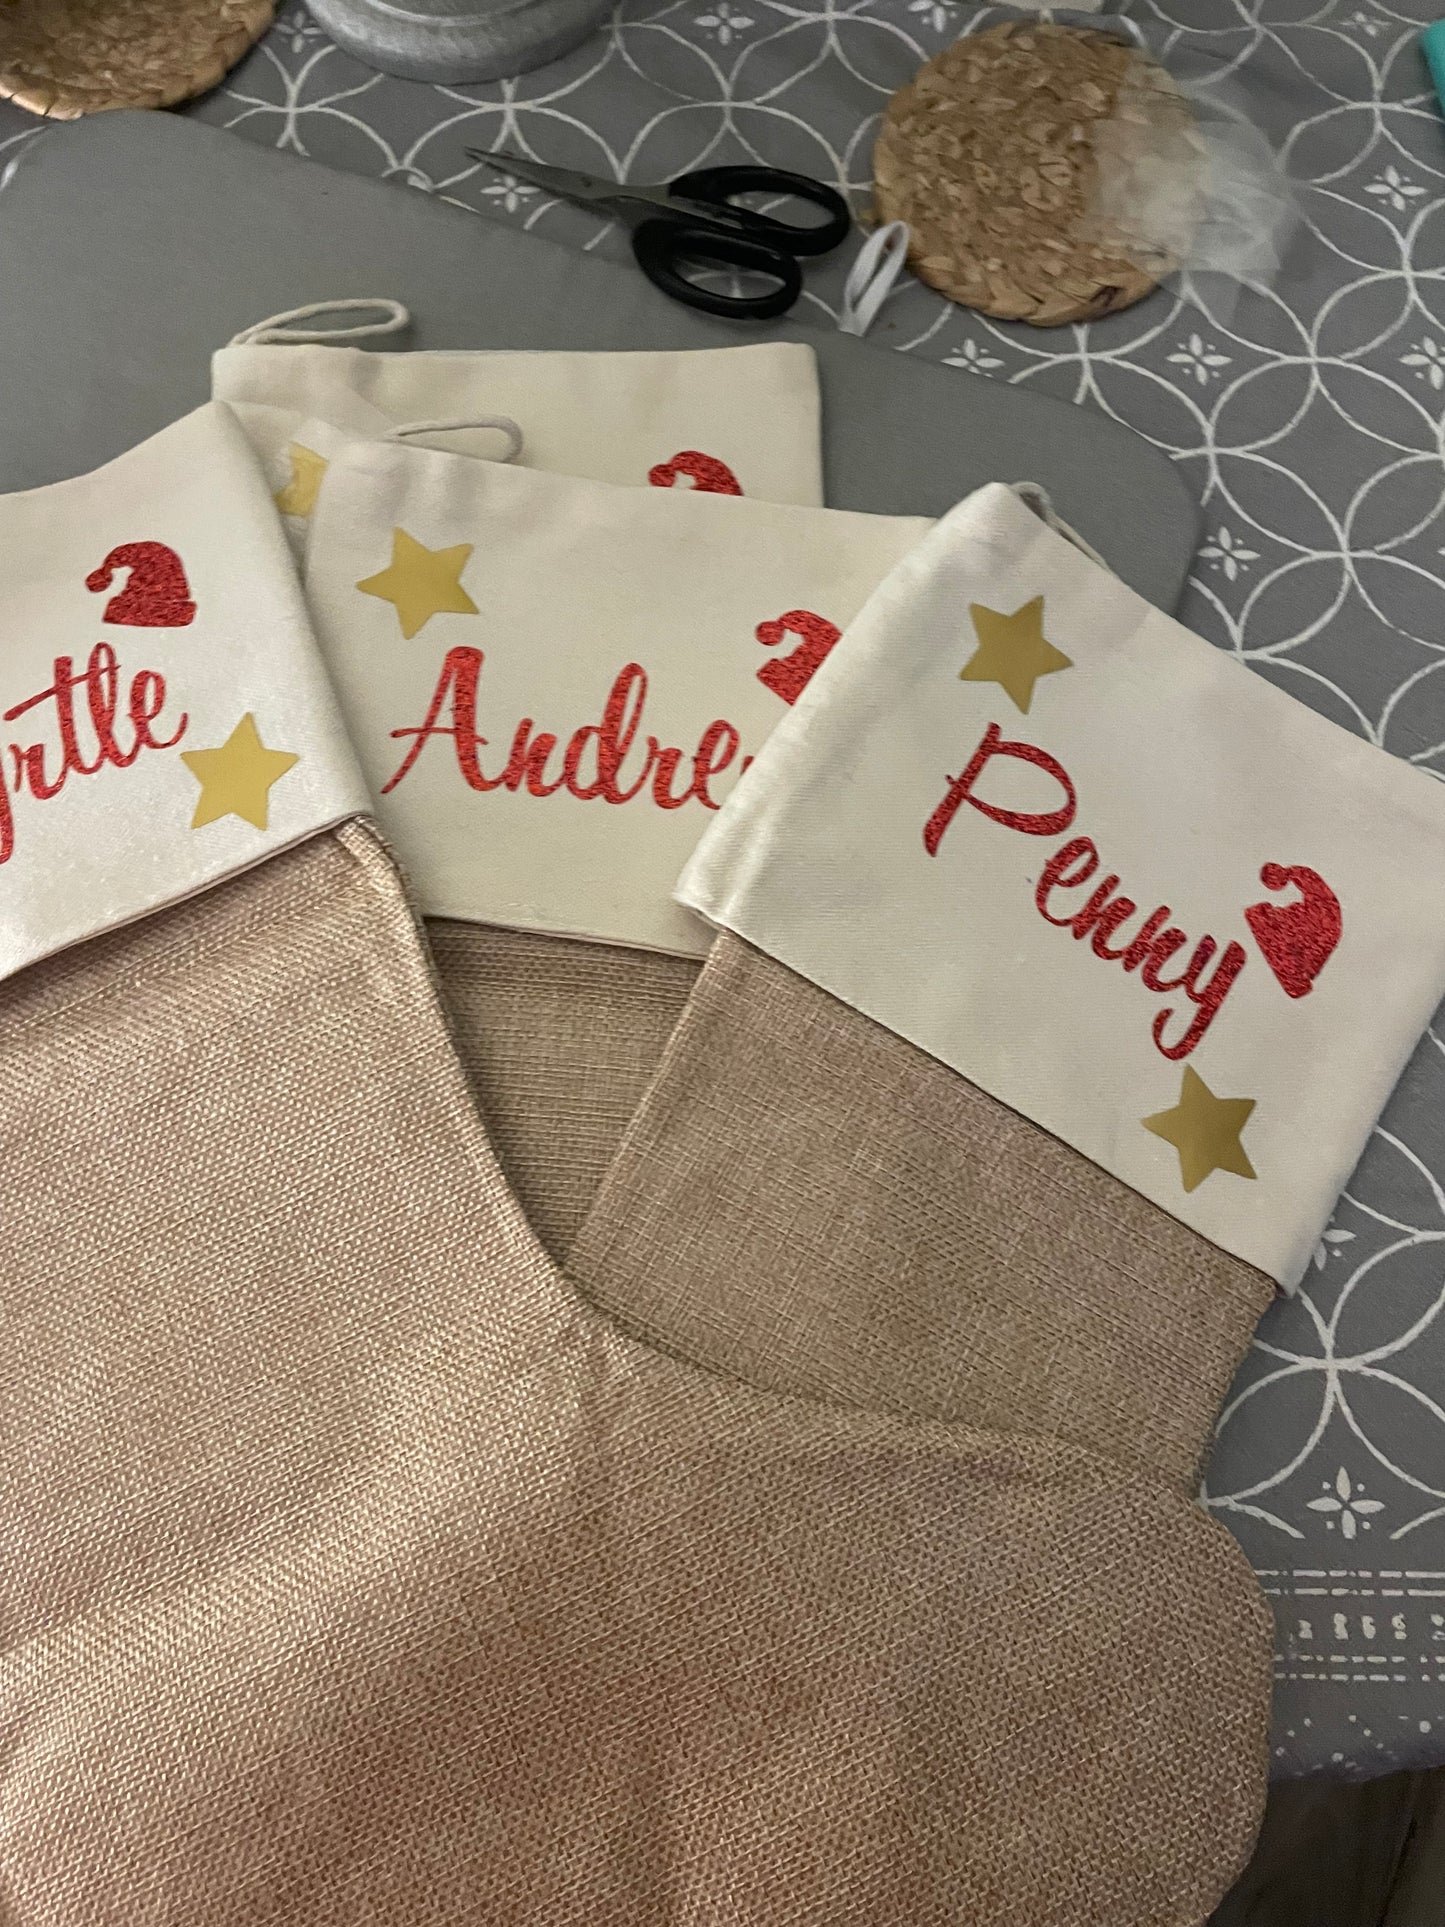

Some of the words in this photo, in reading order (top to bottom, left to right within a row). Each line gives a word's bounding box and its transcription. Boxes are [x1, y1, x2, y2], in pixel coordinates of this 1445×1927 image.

[0, 641, 188, 865] rtle
[380, 646, 754, 810] Andre
[923, 721, 1247, 1060] Penny
